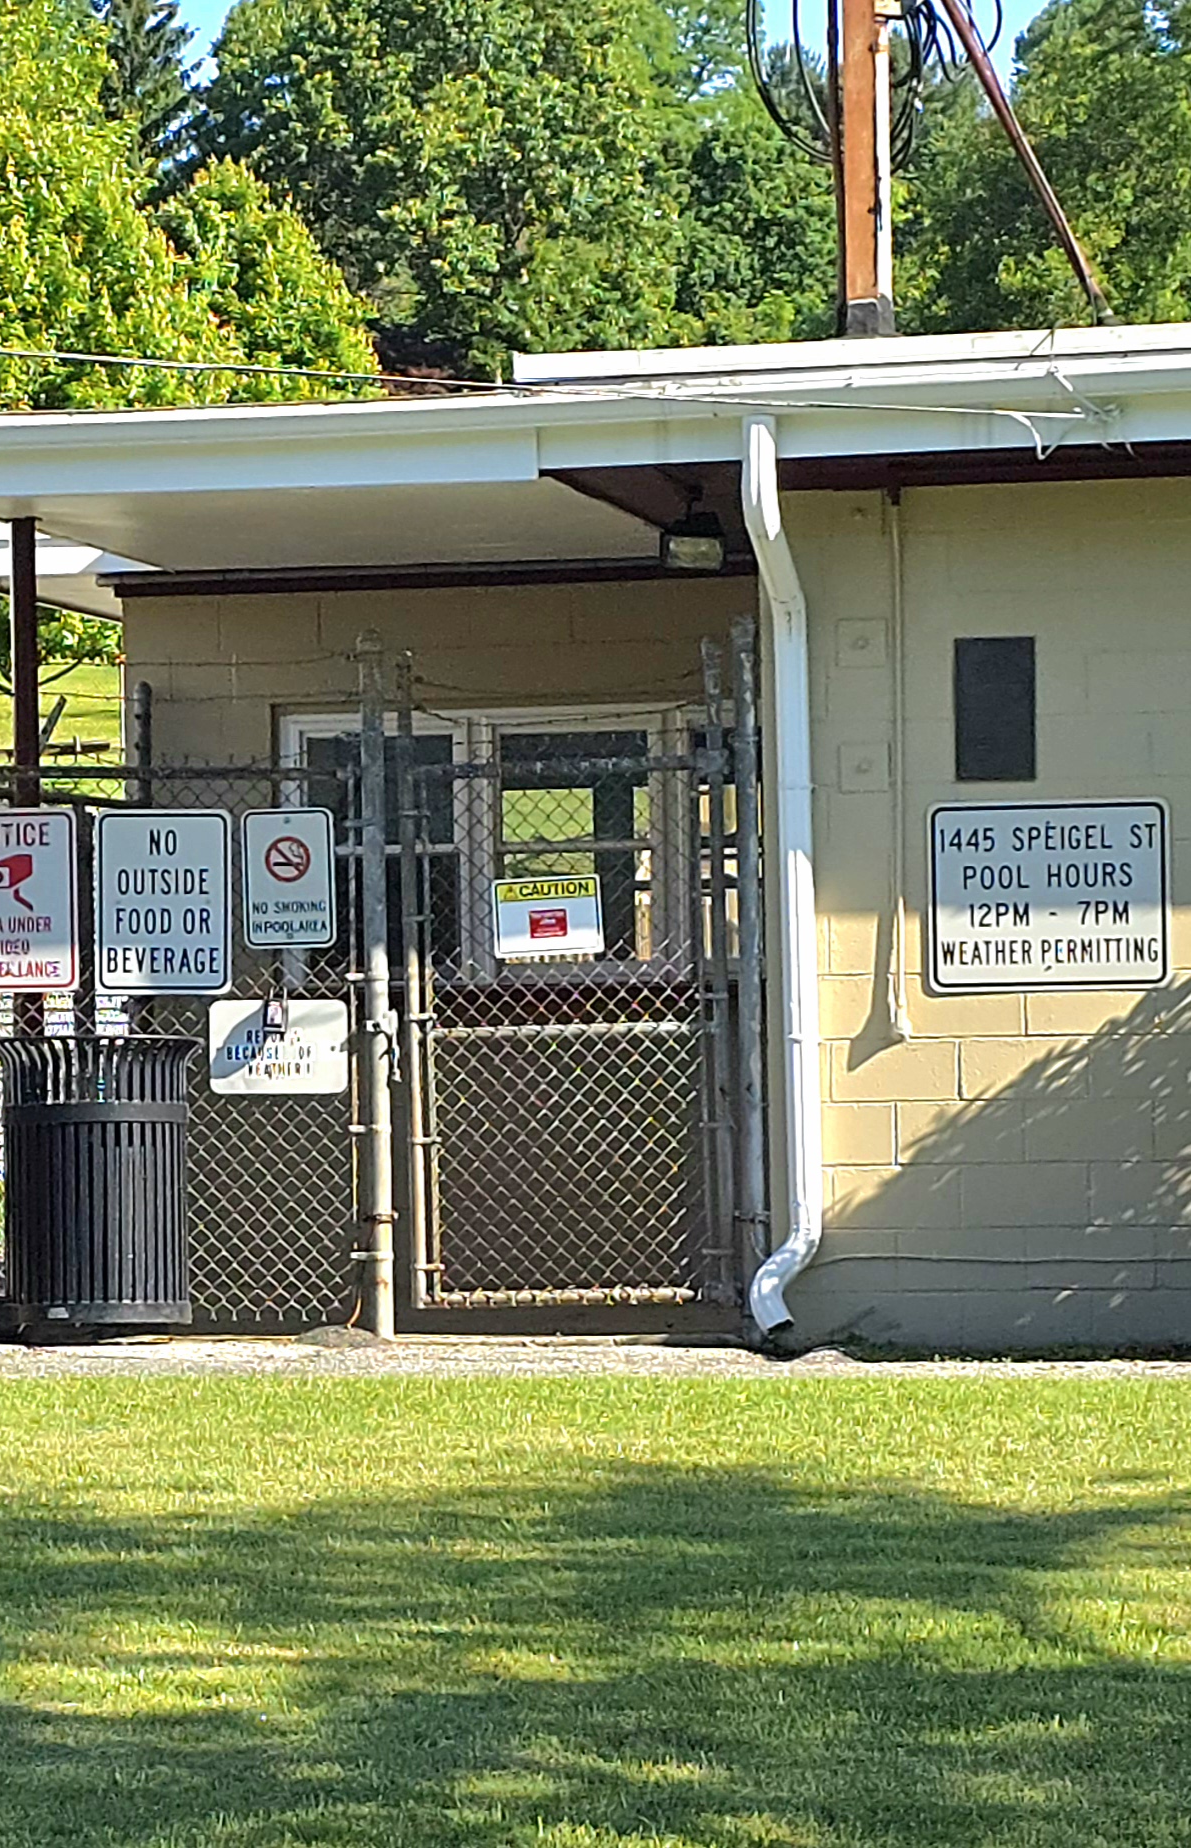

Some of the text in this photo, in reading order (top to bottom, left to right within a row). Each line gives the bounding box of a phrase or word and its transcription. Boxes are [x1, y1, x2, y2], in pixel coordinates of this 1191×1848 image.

[148, 828, 178, 856] NO
[939, 822, 1158, 853] 1445 SPEIGEL ST
[117, 867, 210, 896] OUTSIDE
[518, 881, 590, 898] CAUTION
[962, 862, 1134, 890] POOL HOURS
[115, 907, 212, 935] FOOD OR
[252, 900, 327, 915] NO SMOKING
[968, 901, 1031, 928] 12PM
[1076, 900, 1130, 926] 7PM
[8, 916, 52, 934] UNDER
[264, 920, 297, 934] POOL
[106, 946, 220, 975] BEVERAGE
[940, 937, 1159, 967] WEATHER PERMITTING
[226, 1045, 312, 1061] BECAUSE OF
